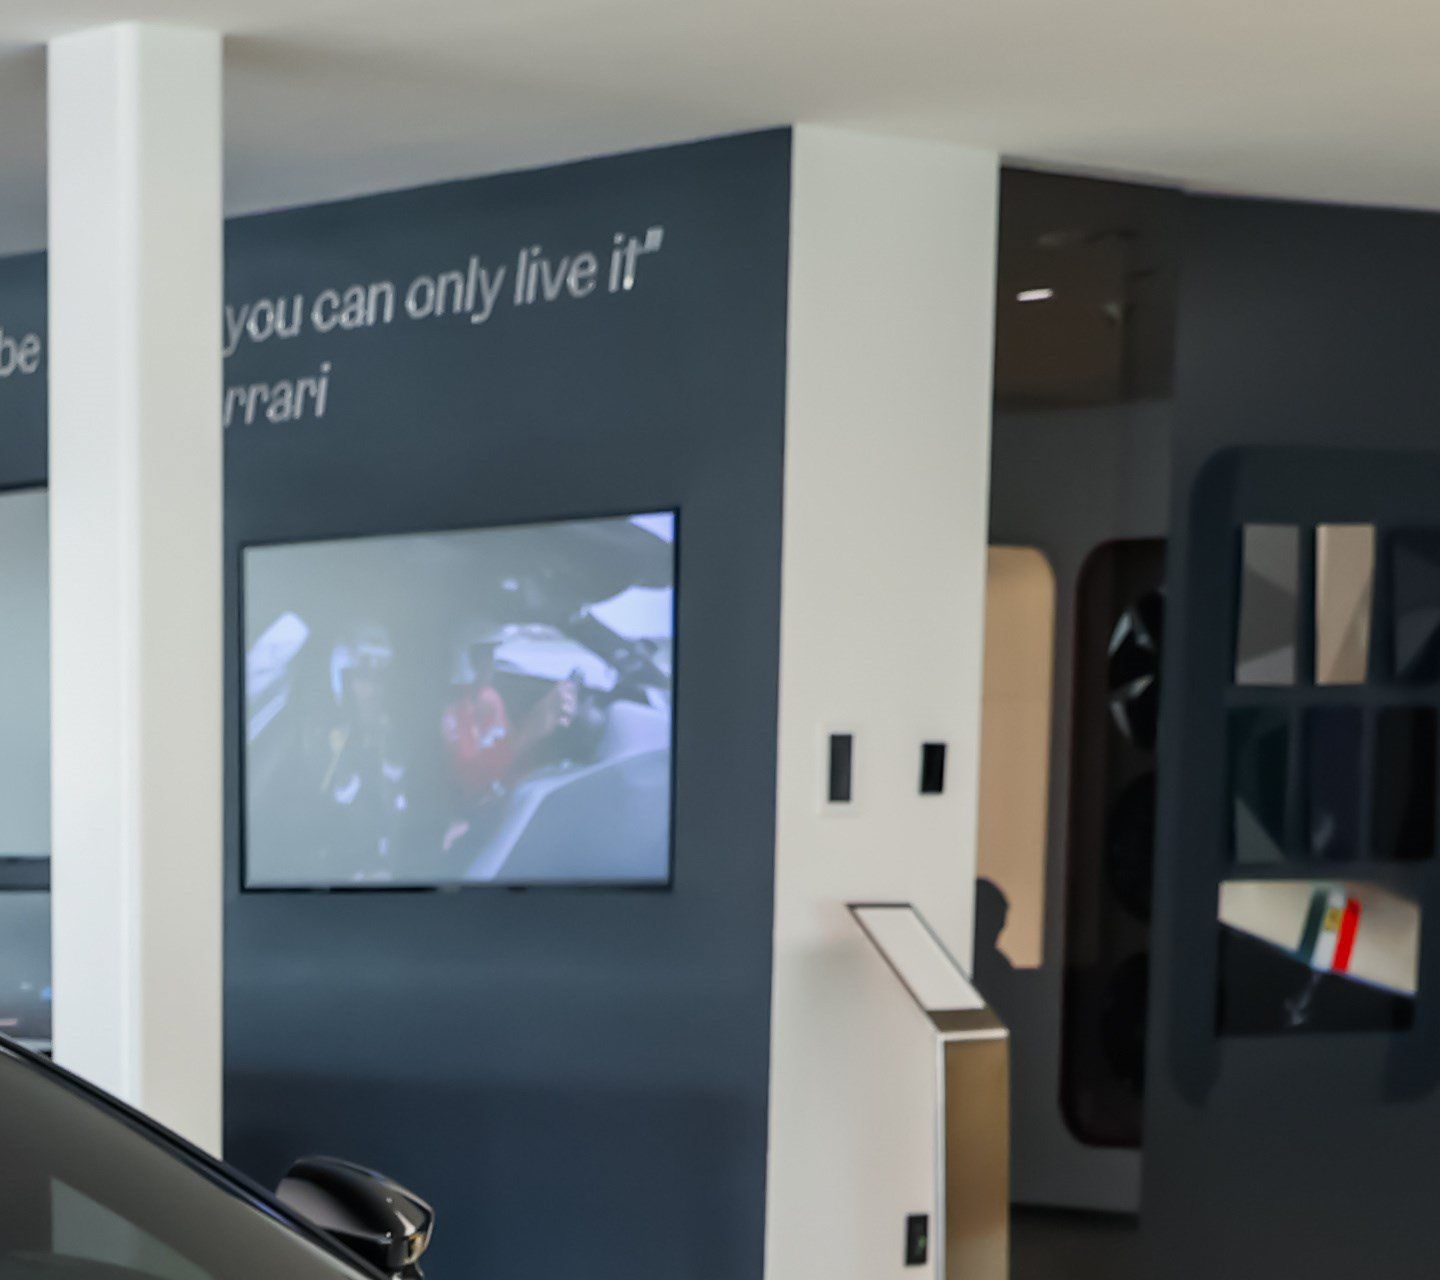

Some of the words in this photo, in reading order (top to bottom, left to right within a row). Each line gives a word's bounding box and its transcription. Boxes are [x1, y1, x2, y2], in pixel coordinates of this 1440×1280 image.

[222, 294, 303, 358] you
[311, 279, 395, 333] can
[405, 255, 506, 325] only
[513, 245, 598, 306] live
[222, 361, 332, 429] rrari
